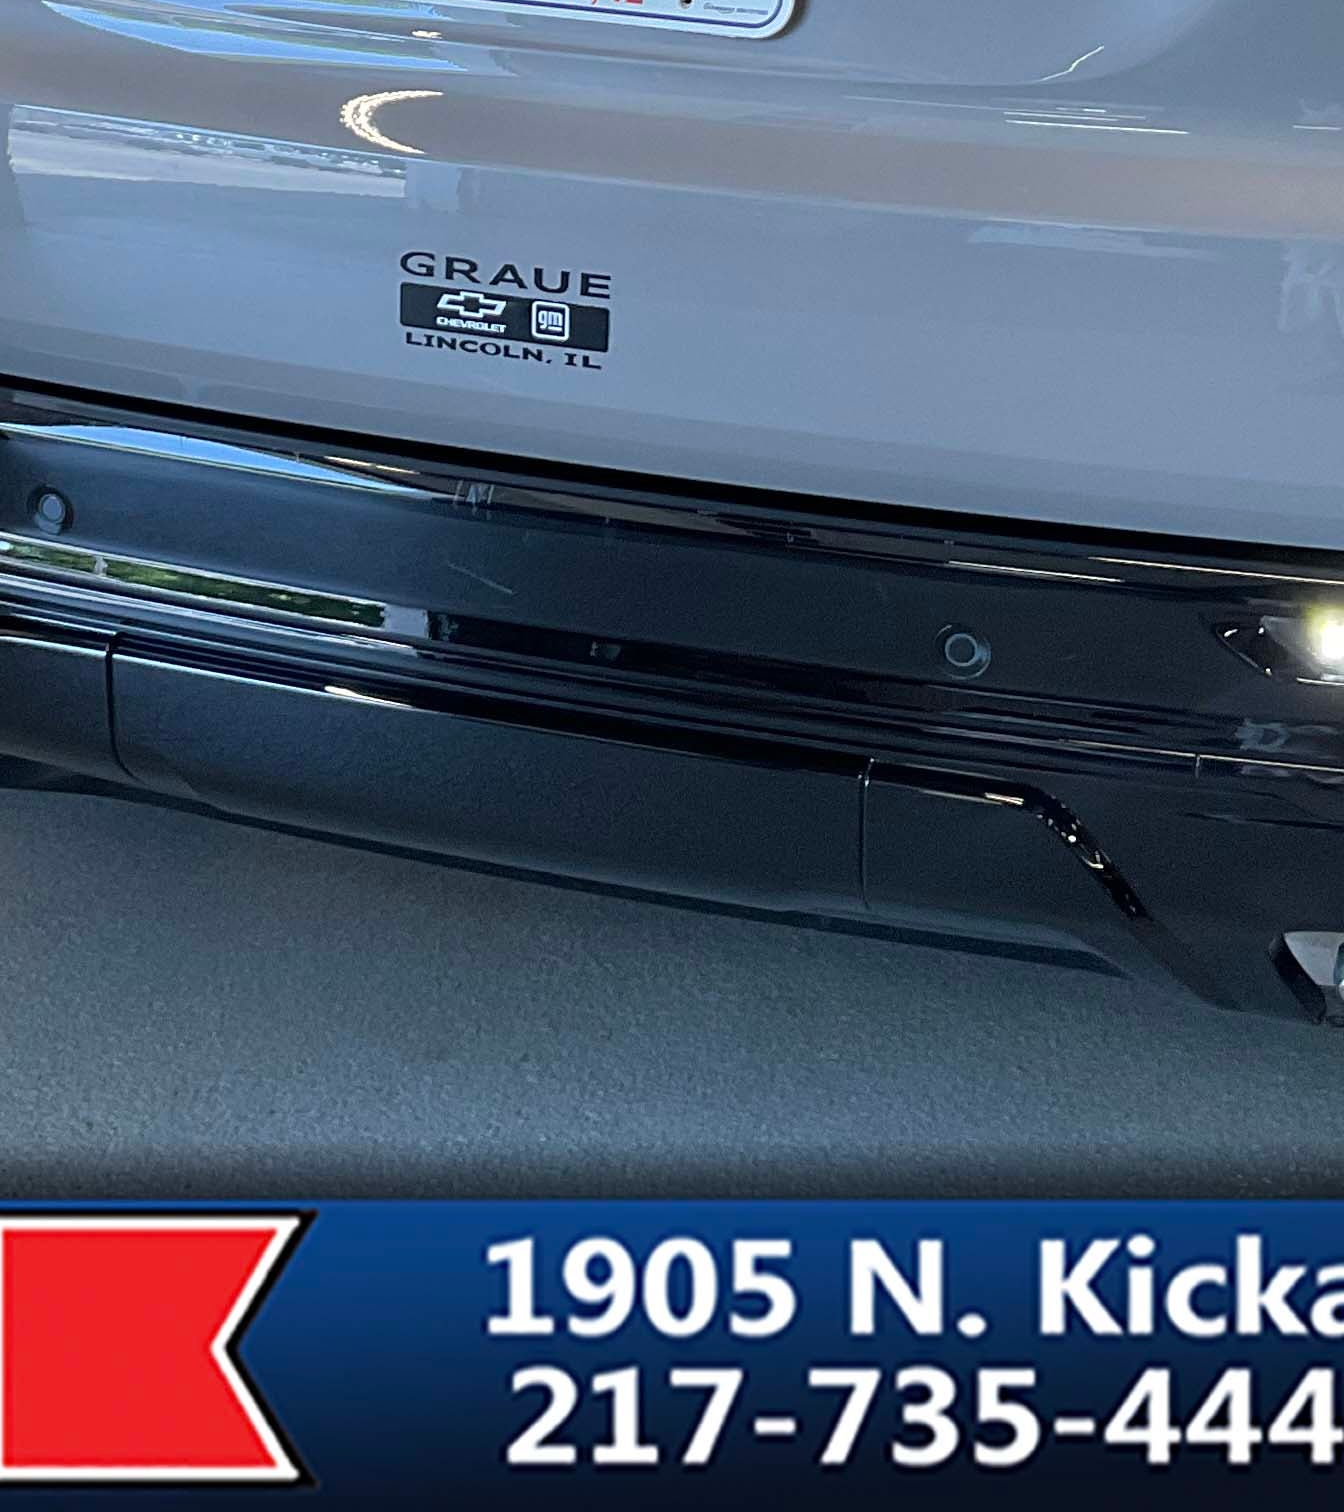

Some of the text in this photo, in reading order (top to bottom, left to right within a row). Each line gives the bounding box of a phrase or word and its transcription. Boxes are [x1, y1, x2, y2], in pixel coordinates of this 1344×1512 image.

[399, 251, 612, 300] GRAUE
[435, 315, 507, 335] CHEVROLET
[537, 308, 565, 332] gm
[406, 331, 603, 371] LINCOLN, IL
